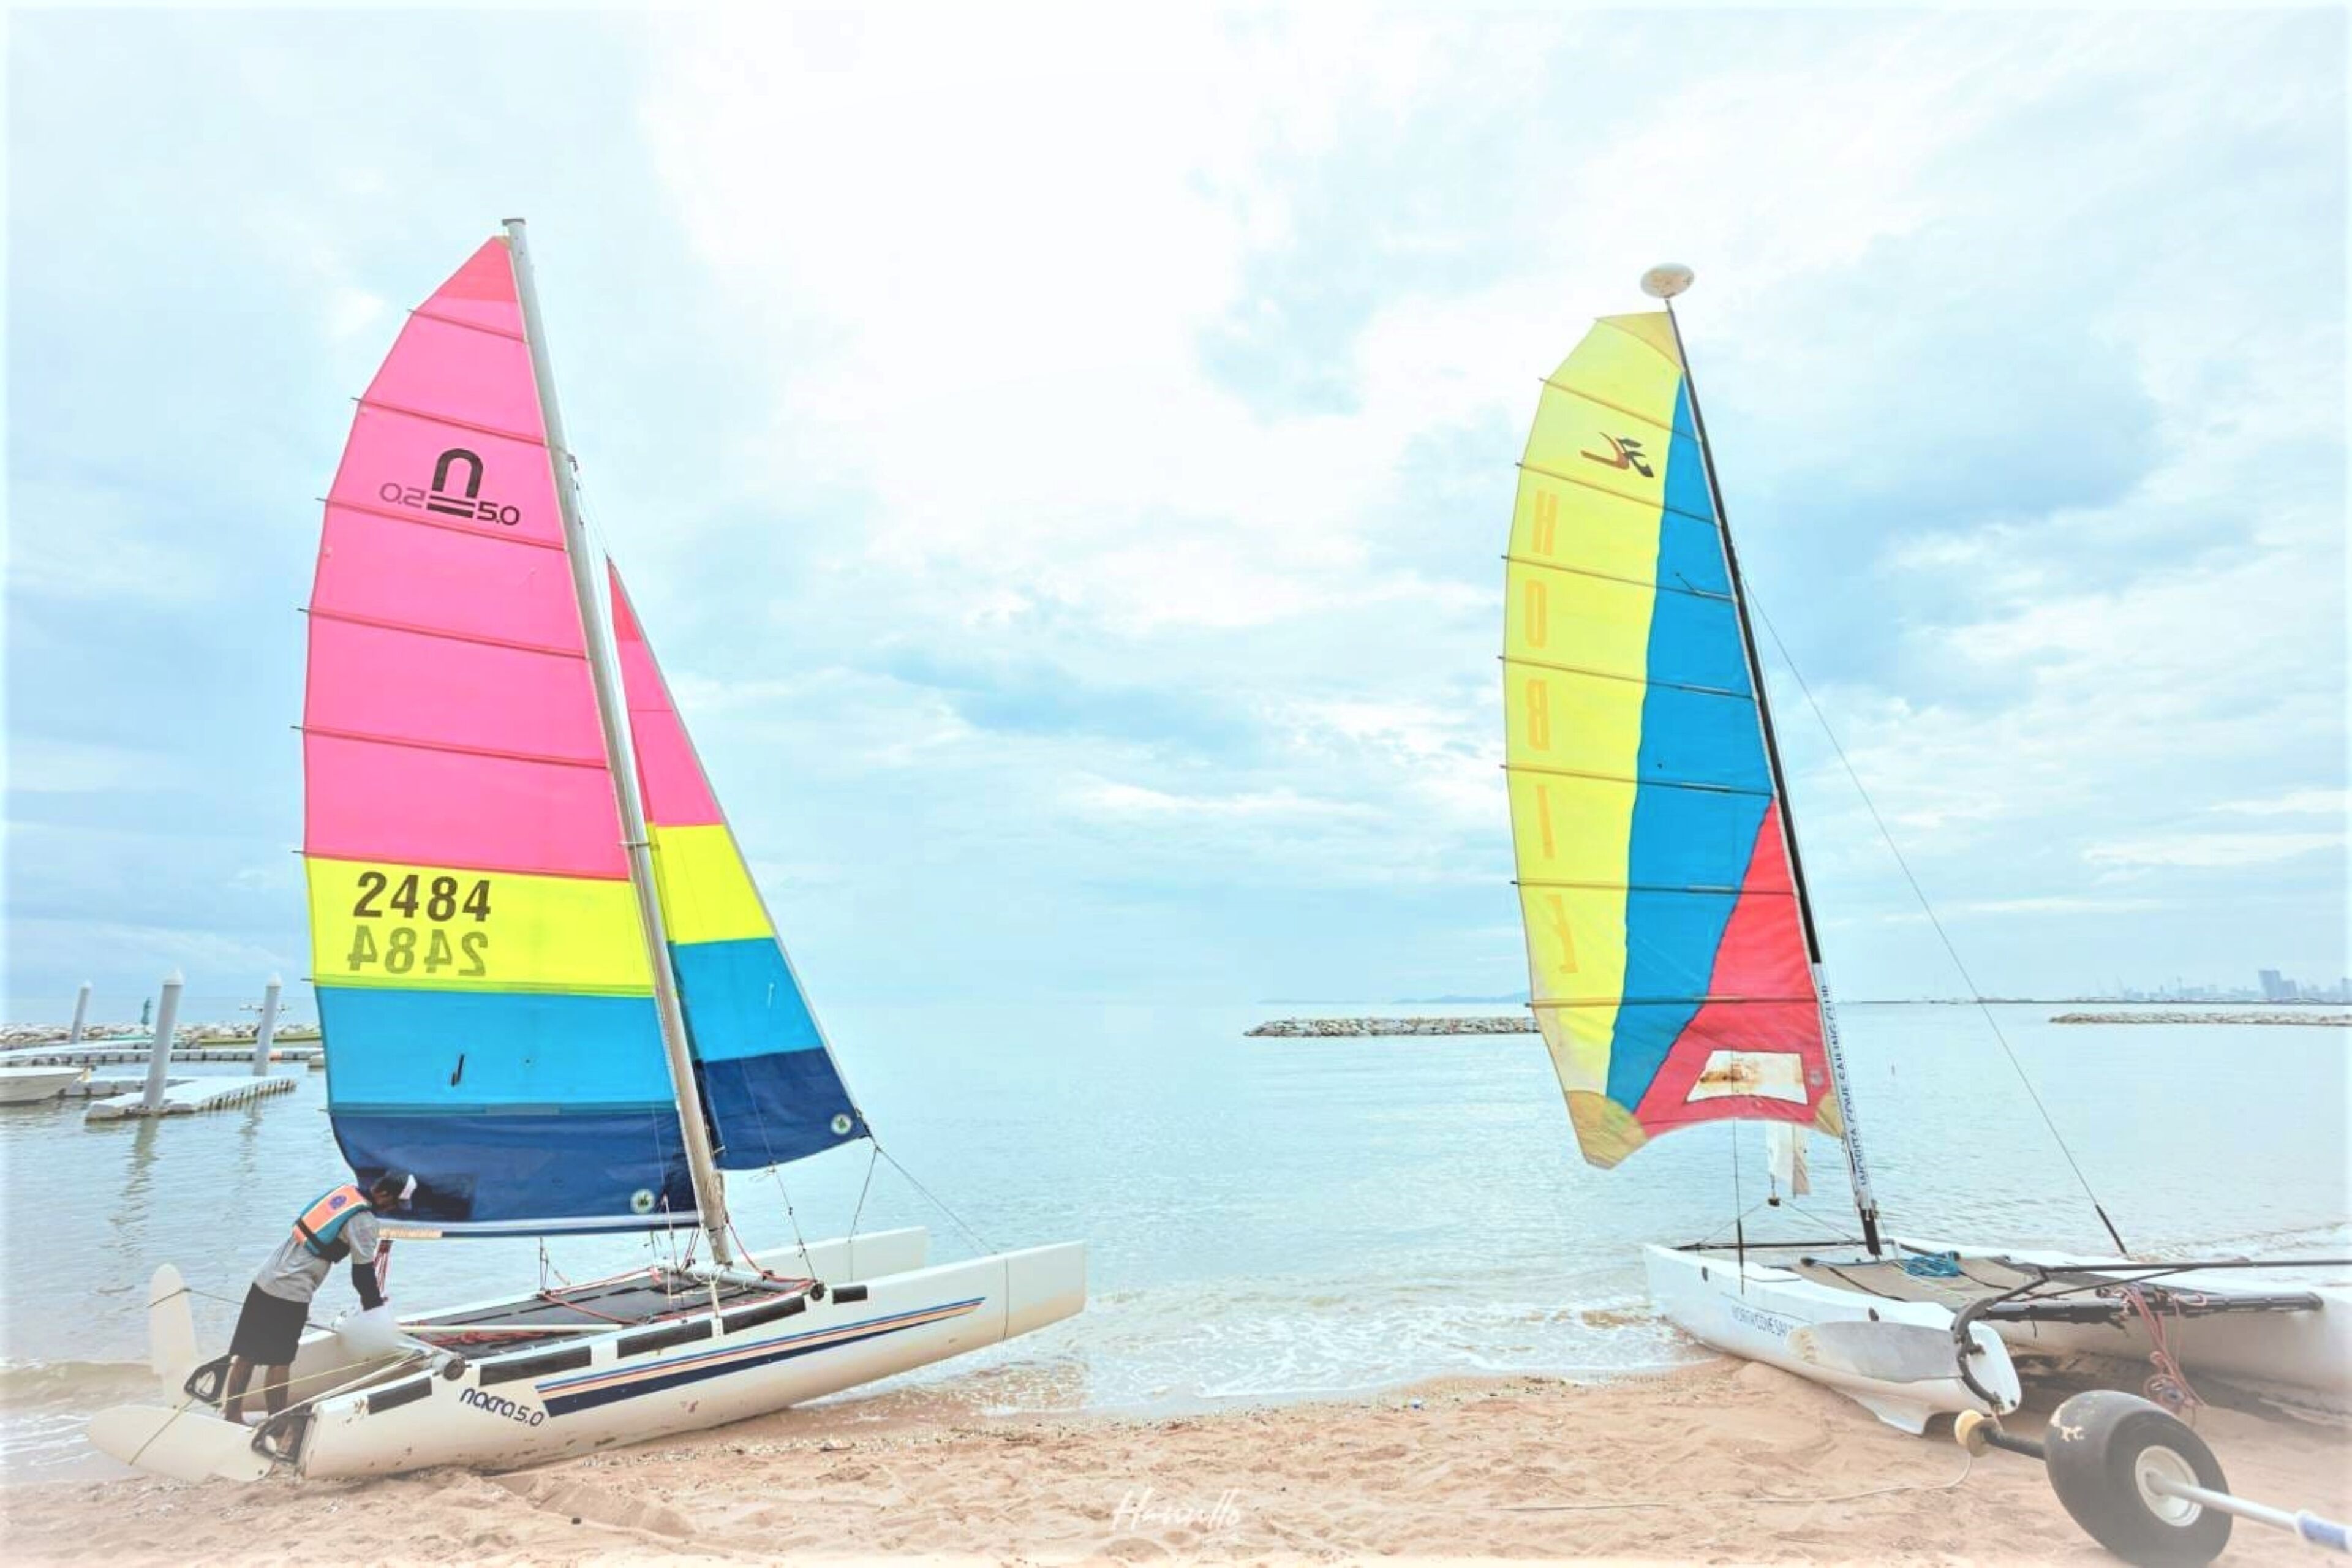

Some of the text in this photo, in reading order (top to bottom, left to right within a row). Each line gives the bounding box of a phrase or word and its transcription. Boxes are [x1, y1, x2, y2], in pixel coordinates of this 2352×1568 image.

[477, 500, 521, 526] 5.0
[353, 871, 492, 922] 2484
[514, 1405, 545, 1427] 5.0
